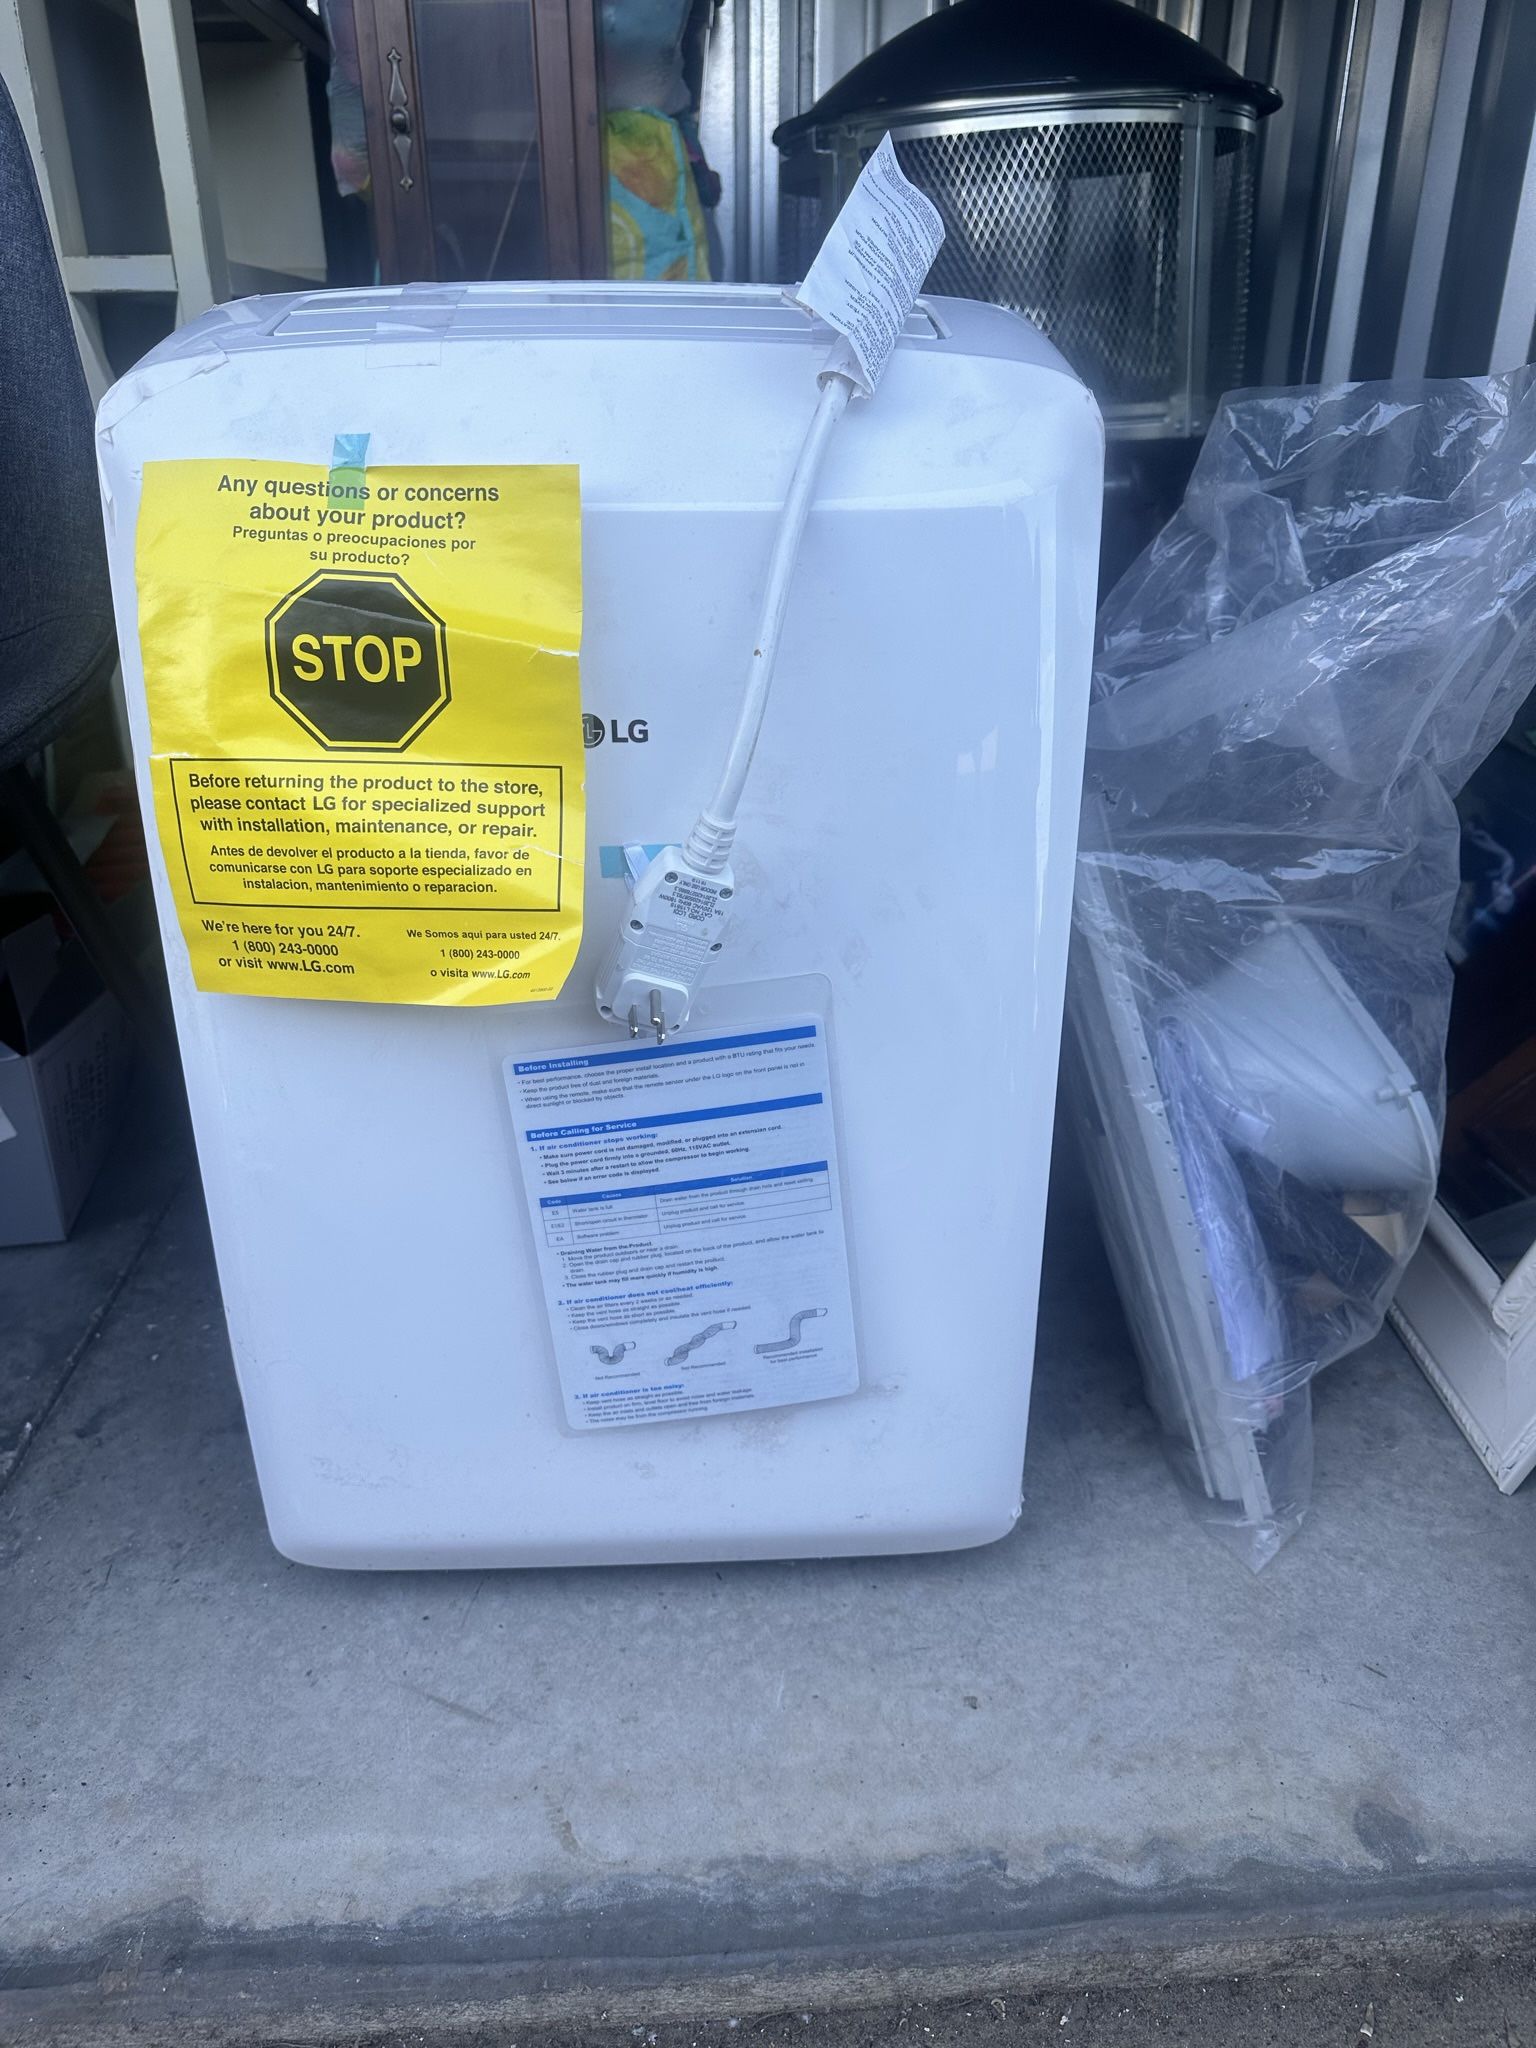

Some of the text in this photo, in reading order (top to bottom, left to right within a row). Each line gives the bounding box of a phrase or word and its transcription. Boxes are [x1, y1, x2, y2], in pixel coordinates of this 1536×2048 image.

[217, 475, 499, 502] Any questions or concerns
[250, 503, 466, 530] about your product?
[233, 526, 476, 552] Preguntas o preocupaciones por
[310, 549, 410, 565] su producto?
[292, 633, 422, 683] STOP
[611, 719, 649, 743] LG
[189, 773, 543, 797] Before returning the product to the store,
[190, 796, 545, 818] please contact LG for specialized support
[200, 818, 537, 838] with installation, maintenance, or repair.
[210, 845, 530, 861] Antes de devolver el producto a la tienda, favor de
[209, 862, 532, 878] comunicarse con LG para soporte especializado en
[243, 878, 497, 894] instalacion, mantenimiento o reparacion.
[202, 919, 361, 938] We're here for you 24/7.
[407, 929, 561, 941] We Somos aqui para usted 24/7.
[232, 940, 339, 956] 1 (800) 243-0000
[440, 949, 520, 960] 1 (800) 243-0000
[218, 957, 355, 974] or visit www.LG.com
[440, 968, 469, 978] visita
[472, 969, 530, 979] www.LG.com
[517, 1057, 589, 1072] Before Installing
[529, 1120, 637, 1139] Before Calling for Service
[558, 1138, 601, 1149] conditioner
[602, 1136, 624, 1144] stops
[625, 1131, 658, 1142] working:
